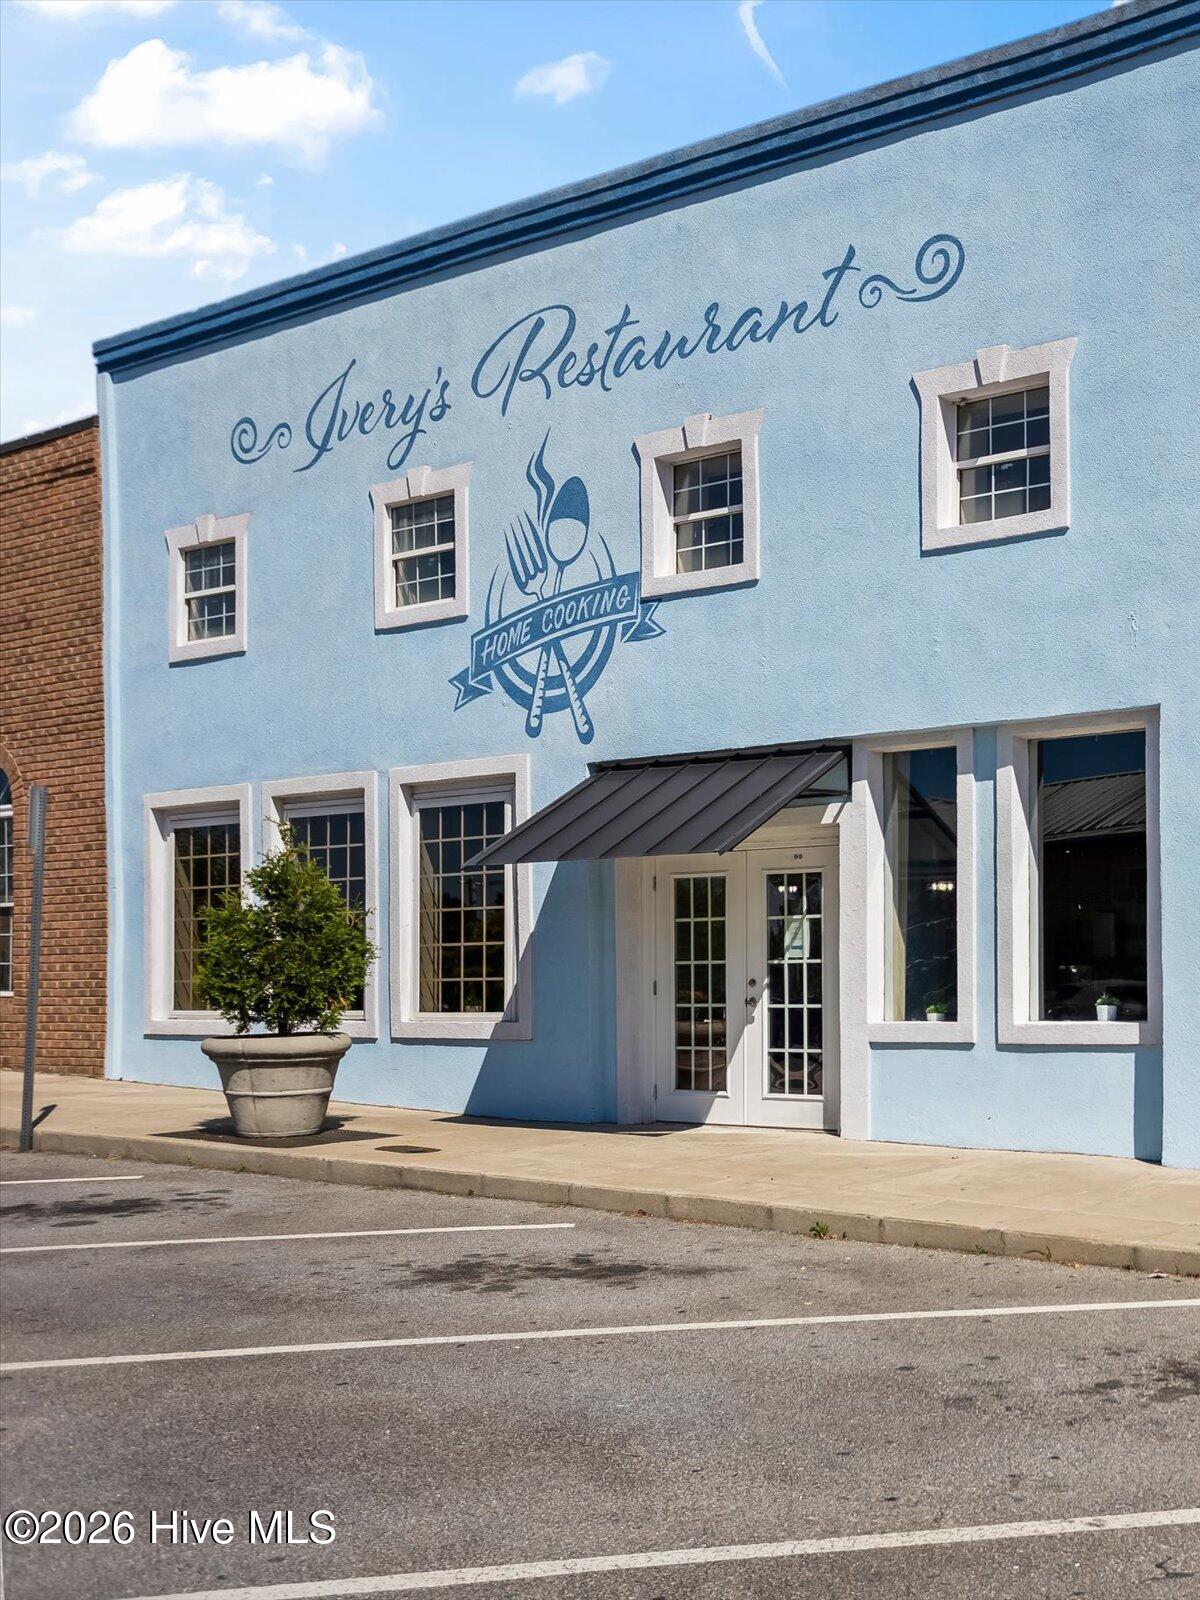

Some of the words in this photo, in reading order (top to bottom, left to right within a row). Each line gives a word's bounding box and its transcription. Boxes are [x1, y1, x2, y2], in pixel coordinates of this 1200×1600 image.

[293, 358, 452, 471] Ivery's
[471, 244, 860, 417] Restaurant
[481, 617, 533, 666] HOME
[541, 584, 631, 634] COOKING
